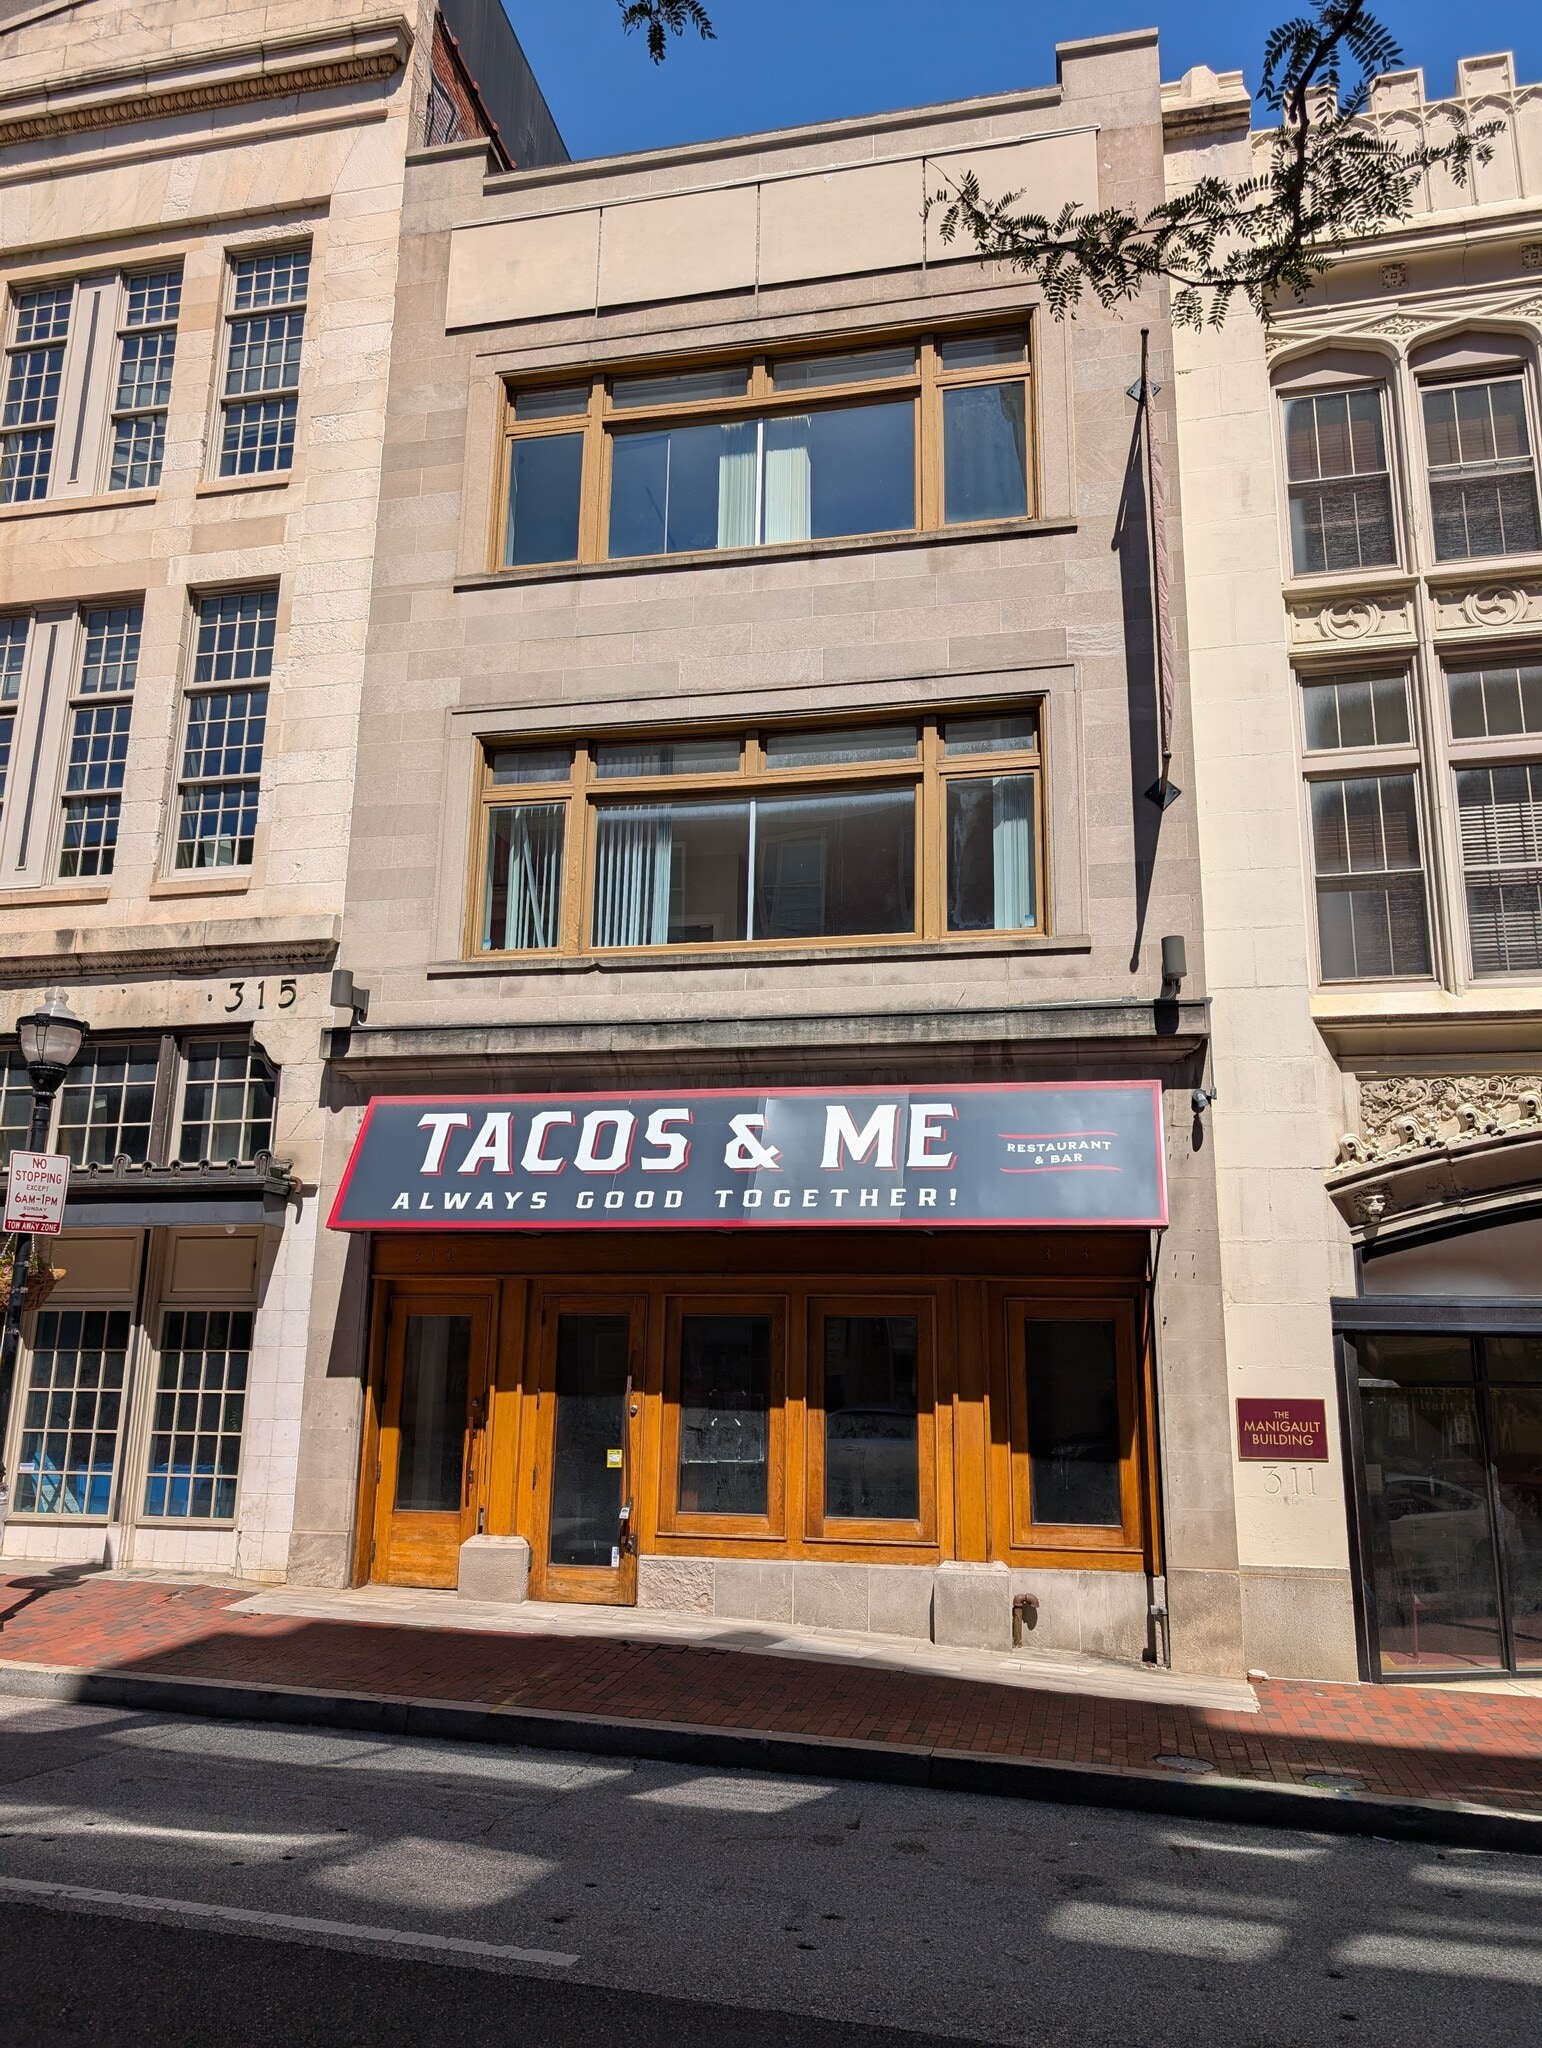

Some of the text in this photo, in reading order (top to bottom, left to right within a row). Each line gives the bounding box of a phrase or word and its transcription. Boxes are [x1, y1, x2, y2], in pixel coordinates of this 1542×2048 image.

[224, 978, 298, 1013] 315
[417, 1103, 960, 1176] TACOS & ME
[1006, 1140, 1112, 1153] RESTAURANT
[32, 1157, 48, 1169] NO
[1034, 1153, 1083, 1165] & BAR
[15, 1169, 63, 1184] STOPPING
[26, 1184, 50, 1192] EXCEPT
[14, 1191, 59, 1206] 6AM-1PM
[391, 1187, 958, 1210] ALWAYS GOOD TOGETHER!
[7, 1221, 58, 1232] TOW AWAY ZONE
[1273, 1410, 1290, 1419] THE
[1243, 1420, 1321, 1433] MANIGAULT
[1252, 1433, 1314, 1446] BUILDING
[1262, 1465, 1318, 1497] 311
